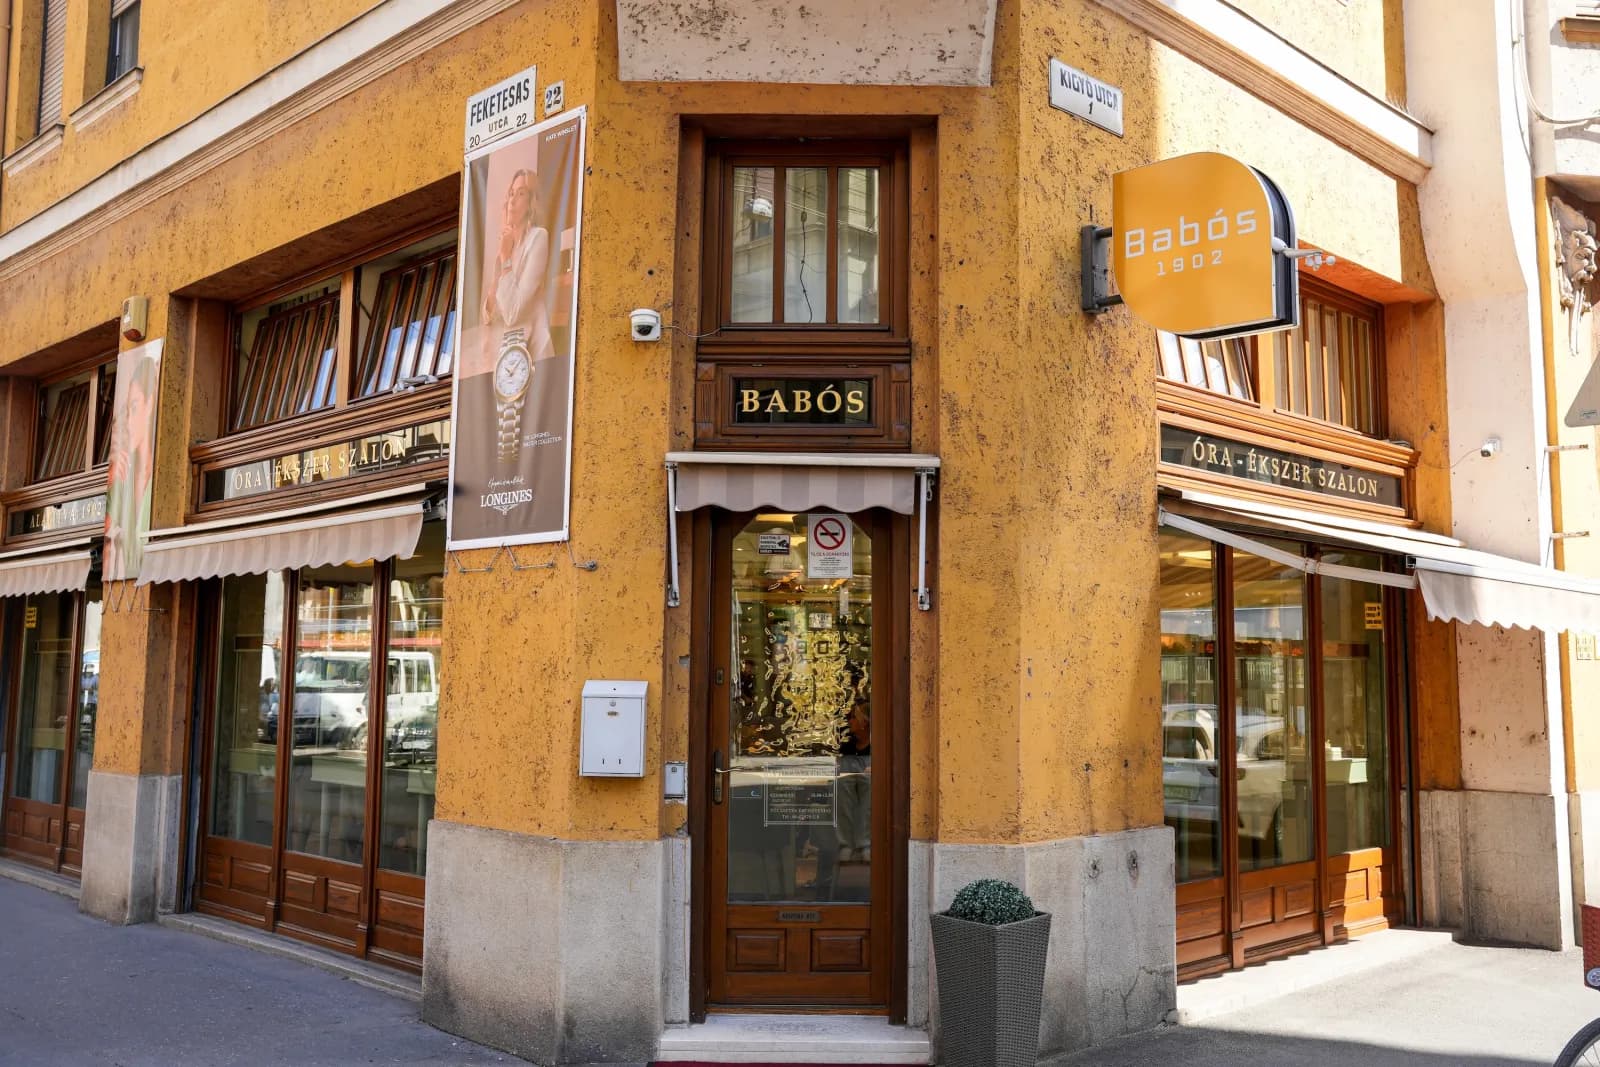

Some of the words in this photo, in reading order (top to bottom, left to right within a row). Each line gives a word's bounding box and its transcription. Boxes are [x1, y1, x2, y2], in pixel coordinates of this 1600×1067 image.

[470, 78, 530, 127] FEKETESAS
[545, 86, 561, 108] 22
[1088, 101, 1093, 114] 1
[1095, 83, 1118, 111] UTCA
[470, 134, 480, 148] 20
[516, 113, 527, 127] 22
[488, 116, 508, 132] UTCA
[1125, 208, 1257, 258] Babós
[1156, 249, 1222, 276] 1902
[741, 384, 864, 414] BABÓS
[338, 440, 406, 469] SZALON
[1319, 468, 1378, 497] SZALON
[480, 488, 533, 507] LONGINES
